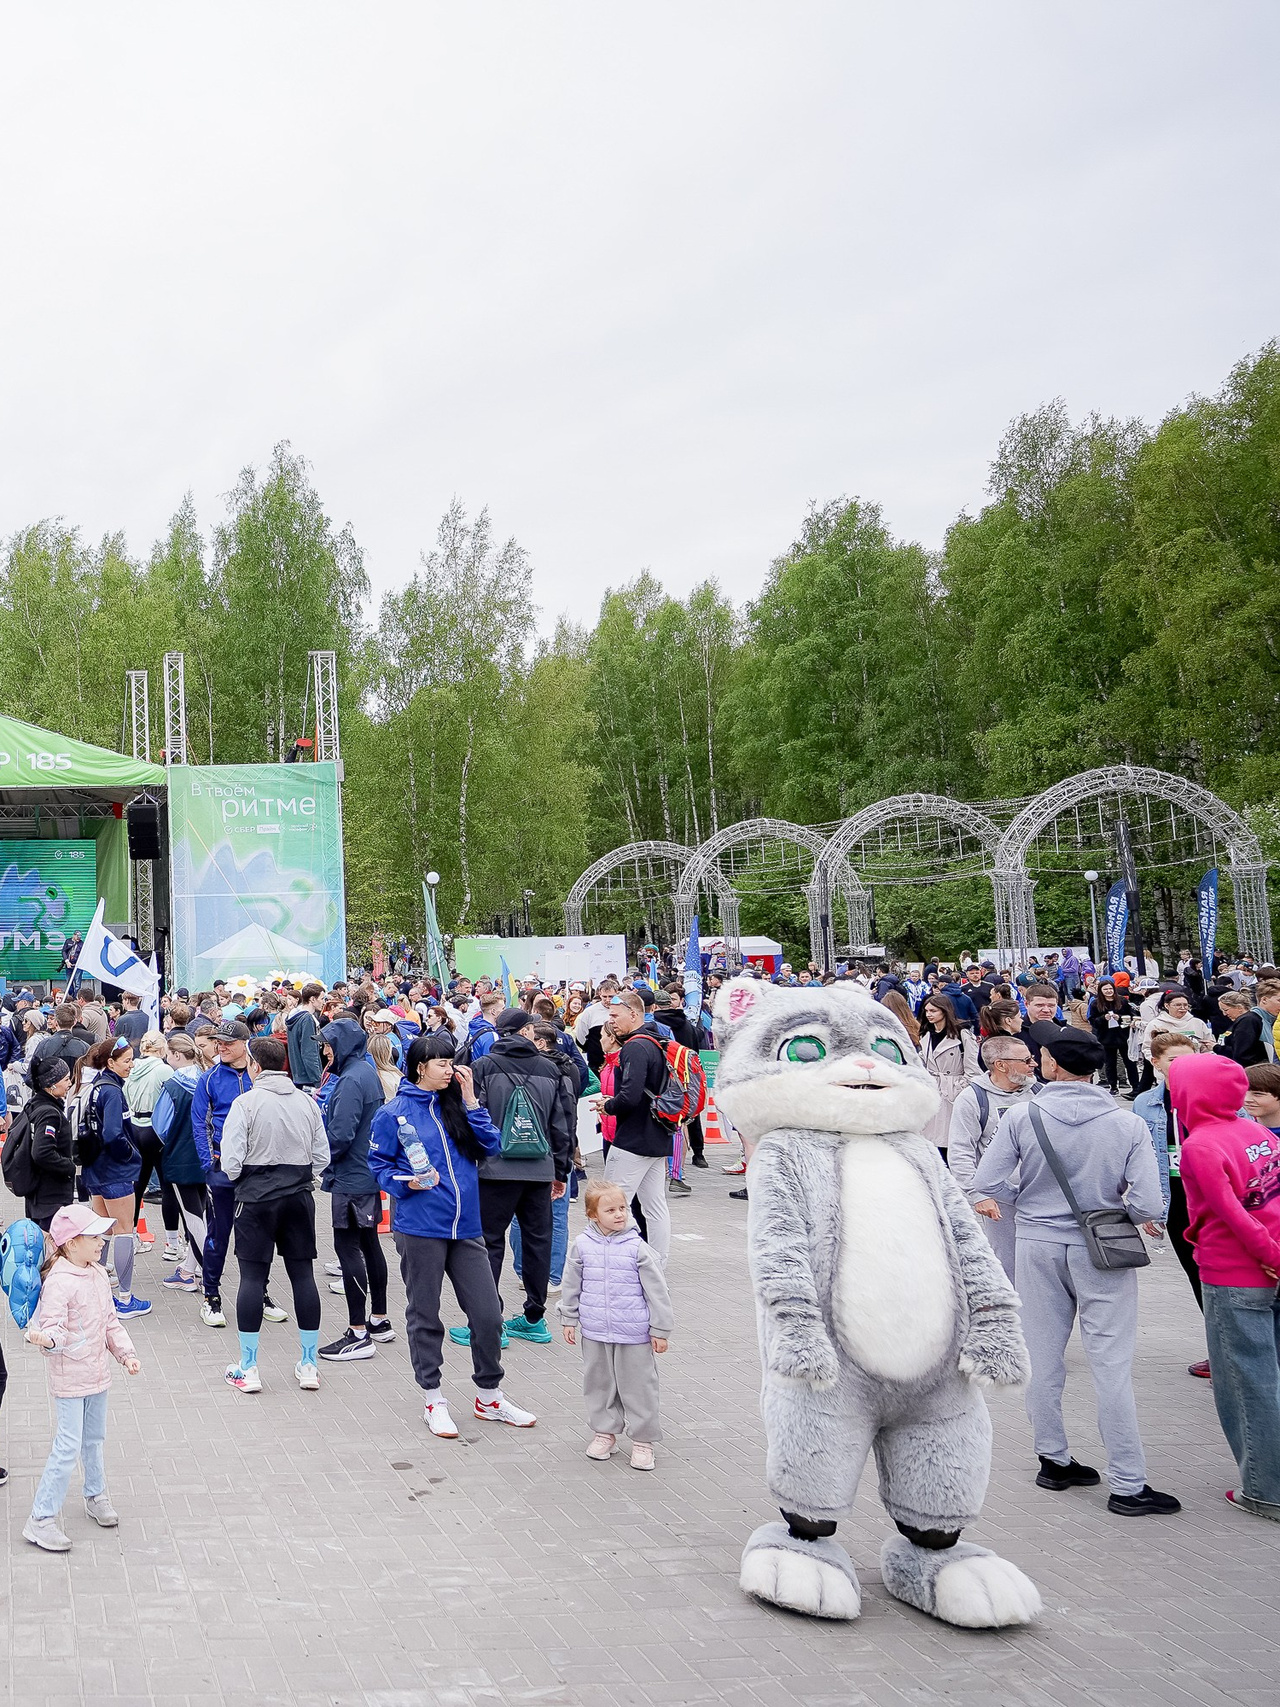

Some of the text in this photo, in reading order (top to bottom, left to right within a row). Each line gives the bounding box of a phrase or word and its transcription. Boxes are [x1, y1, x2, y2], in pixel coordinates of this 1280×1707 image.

[26, 752, 72, 771] 185
[192, 783, 256, 798] В твоём
[222, 796, 316, 823] ритме
[69, 851, 85, 859] 185
